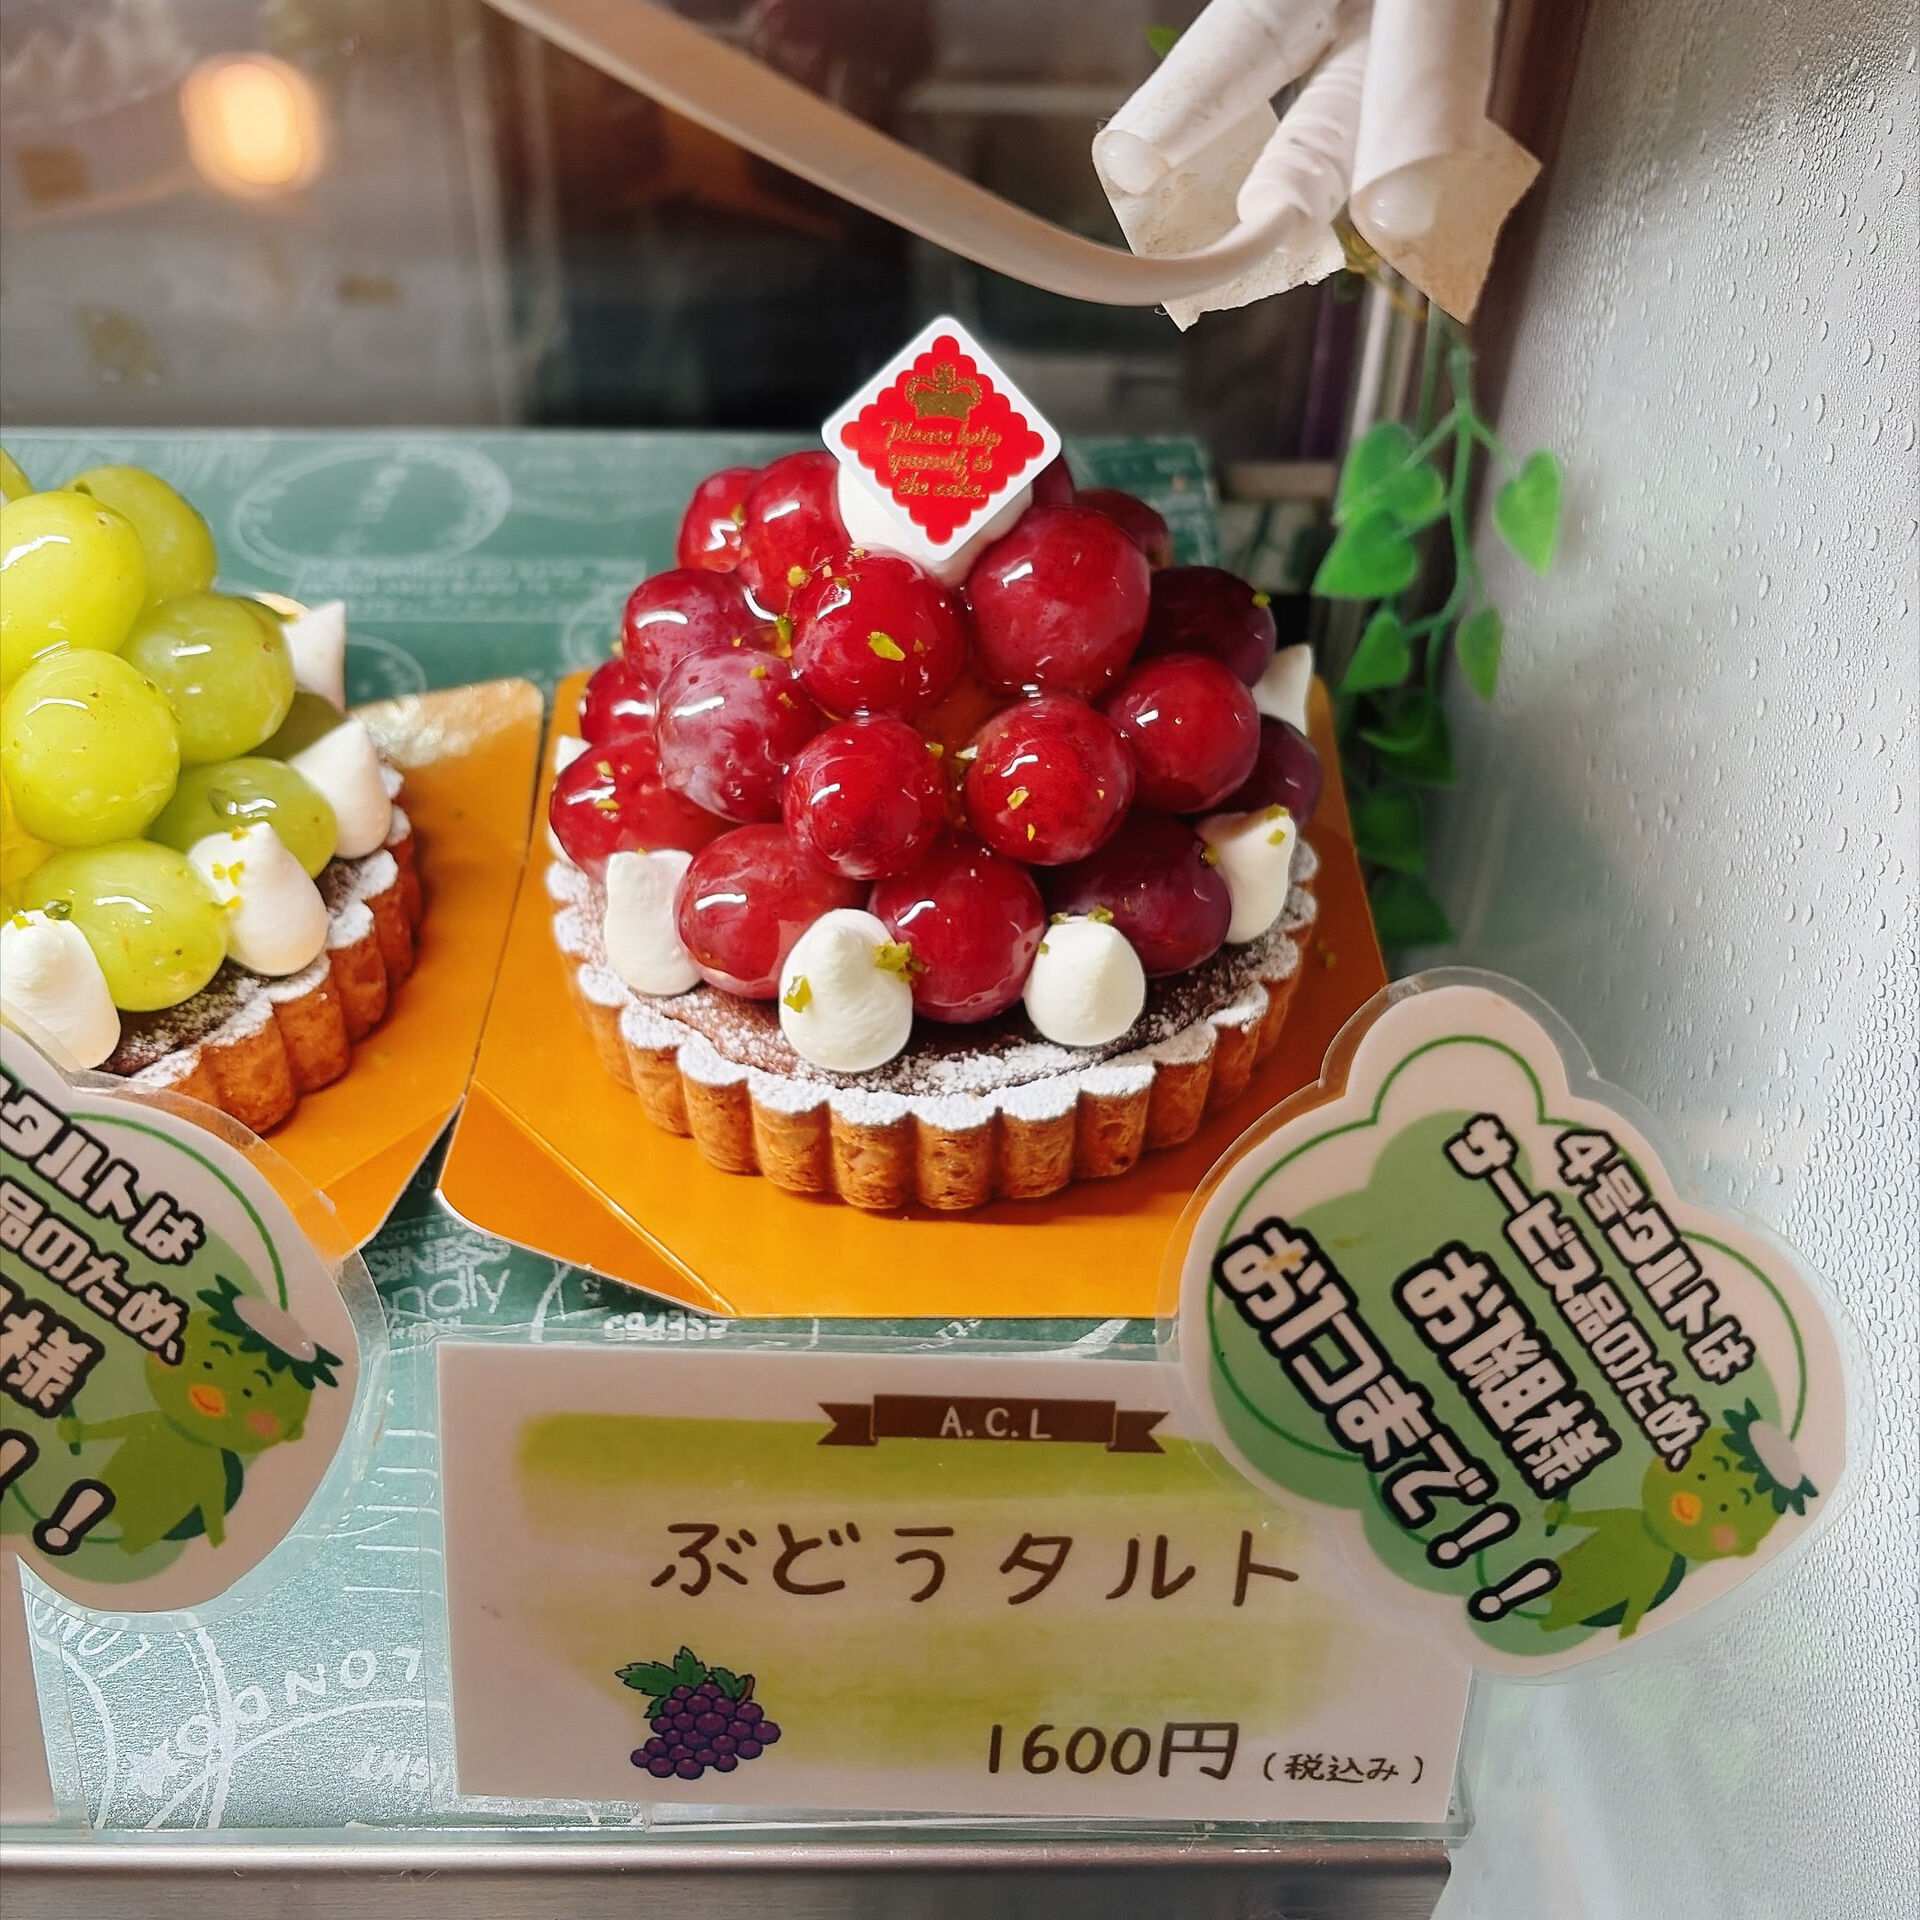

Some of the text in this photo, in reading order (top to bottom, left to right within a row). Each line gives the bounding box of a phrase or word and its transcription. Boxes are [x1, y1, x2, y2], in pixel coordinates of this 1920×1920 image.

[881, 417, 1002, 449] Please help
[897, 472, 929, 495] the
[0, 1073, 207, 1266] タルトは
[1444, 1113, 1710, 1472] サービス品のため、
[1556, 1128, 1758, 1386] 4号タルトは
[1392, 1240, 1621, 1498] お1組様
[940, 1406, 1051, 1439] A.C.L
[650, 1522, 1300, 1607] ぶどうタルト
[987, 1722, 1240, 1780] 1600円
